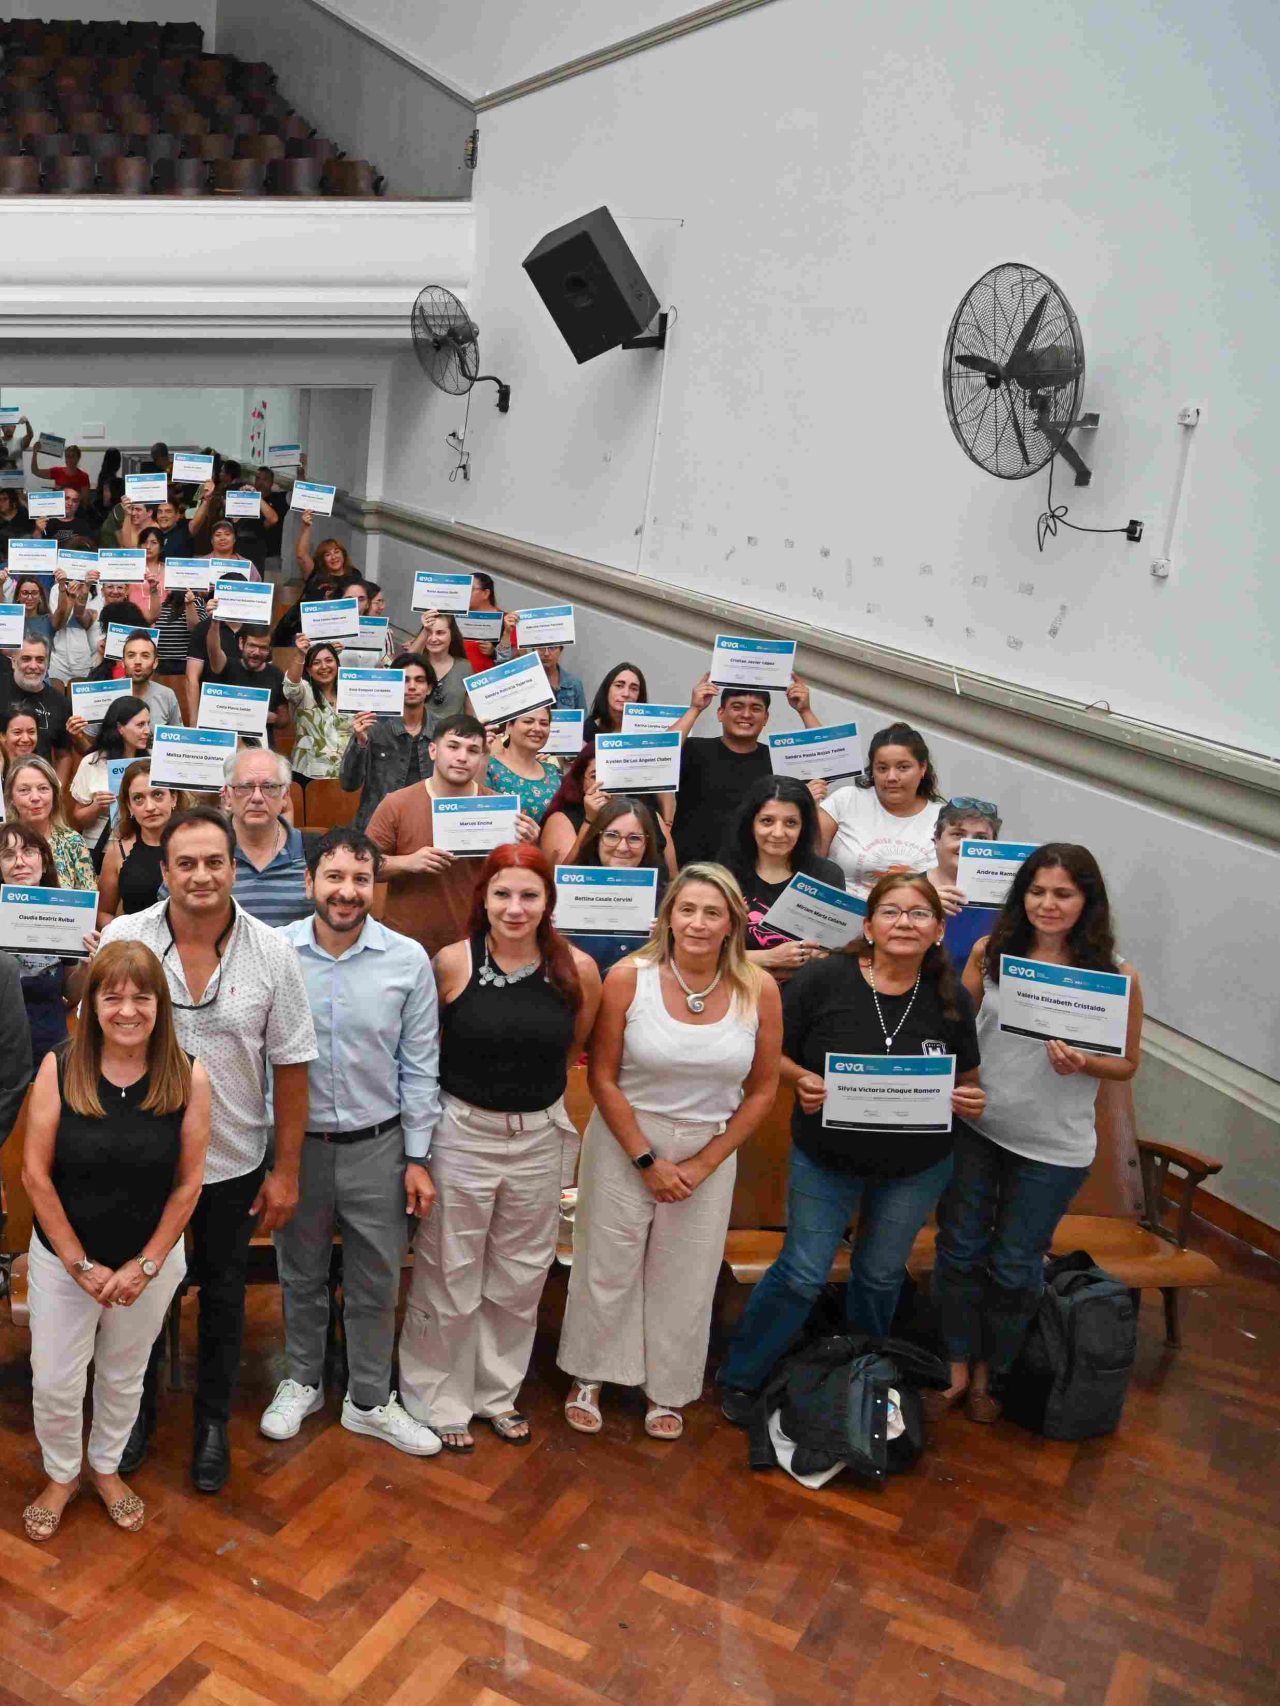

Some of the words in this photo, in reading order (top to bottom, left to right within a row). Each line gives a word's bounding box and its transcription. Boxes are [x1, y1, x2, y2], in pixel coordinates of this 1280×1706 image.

[111, 625, 123, 633] eva
[720, 640, 739, 649] eva
[470, 677, 489, 688] eva
[206, 687, 223, 696] eva
[628, 707, 644, 715] eva
[160, 731, 181, 742] eva
[602, 740, 623, 748] eva
[773, 737, 795, 747] eva
[112, 767, 125, 775] ev
[438, 803, 460, 811] eva
[967, 846, 994, 857] eva
[561, 873, 585, 882] eva
[796, 880, 819, 895] eva
[7, 891, 29, 902] eva
[796, 902, 814, 914] Miriam
[1008, 965, 1036, 979] eva
[1016, 990, 1040, 1001] Valeria
[1040, 996, 1073, 1007] Elizabeth
[1073, 1002, 1107, 1013] Cristaldo
[835, 1062, 865, 1072] eva
[886, 1087, 913, 1095] Choque
